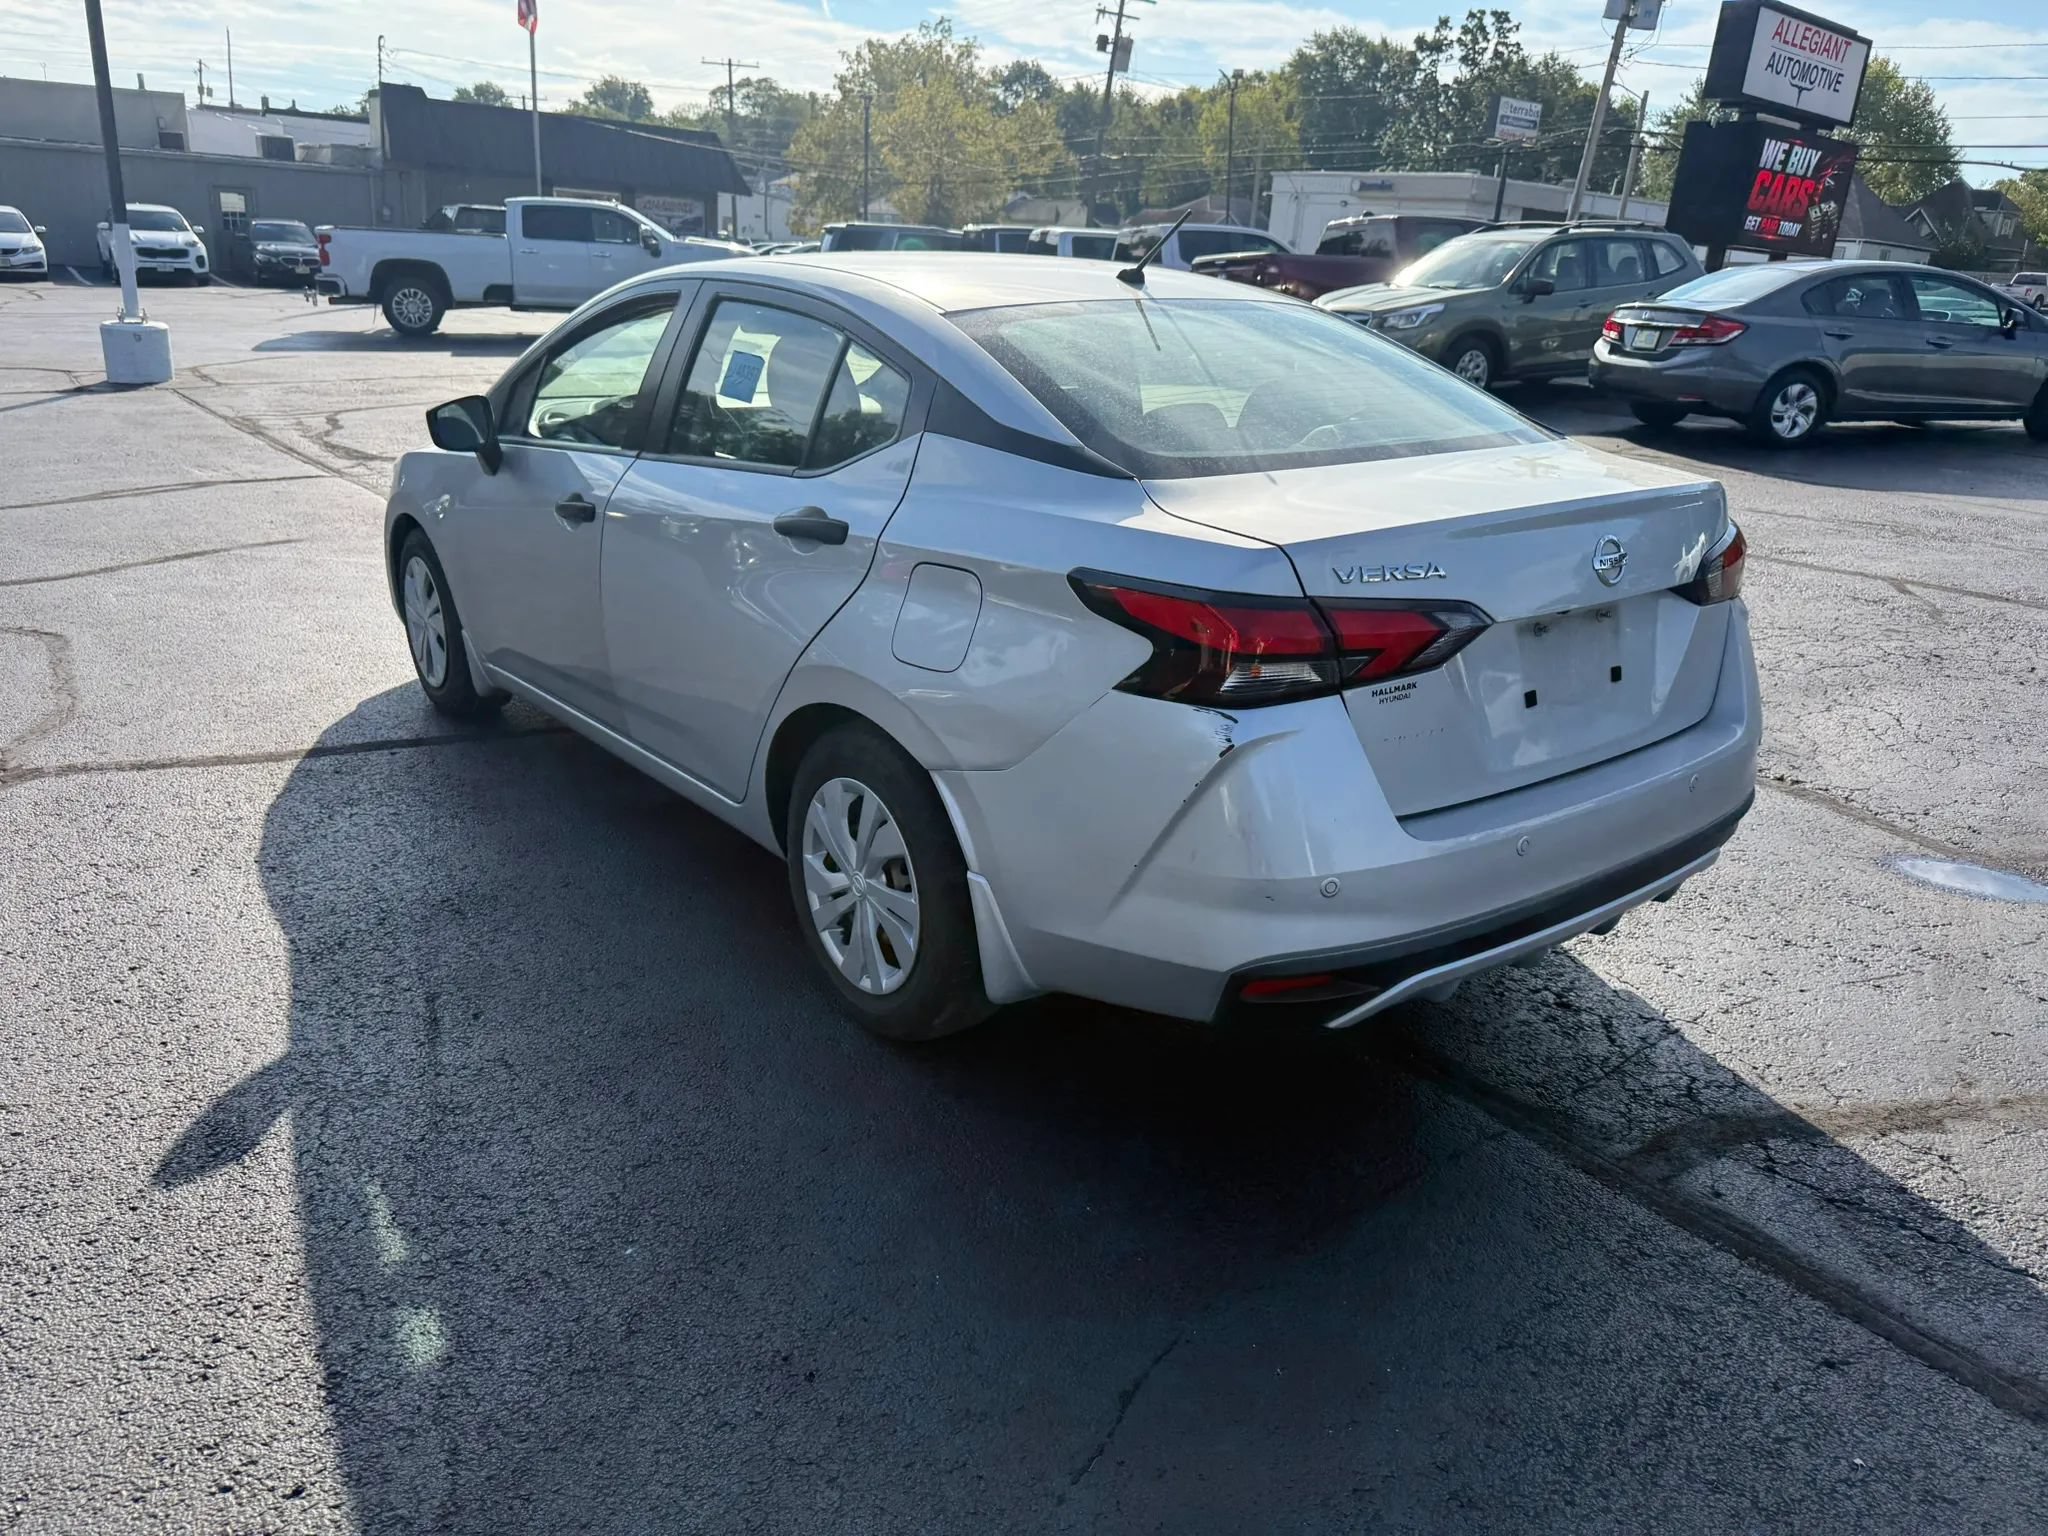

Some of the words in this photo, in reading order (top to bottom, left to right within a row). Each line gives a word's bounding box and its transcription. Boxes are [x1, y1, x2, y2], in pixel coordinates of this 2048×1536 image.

[1772, 18, 1852, 63] ALLEGIANT
[1765, 52, 1844, 92] AUTOMOTIVE
[1510, 103, 1540, 118] terrabis
[1759, 138, 1790, 171] WE
[1785, 145, 1822, 178] BUY
[1748, 170, 1816, 217] CARS
[1744, 215, 1761, 231] GET
[1777, 221, 1802, 237] TODAY
[1332, 562, 1447, 584] VERSA
[1371, 681, 1417, 697] HALLMARK
[1379, 692, 1411, 704] HYUNDAI
